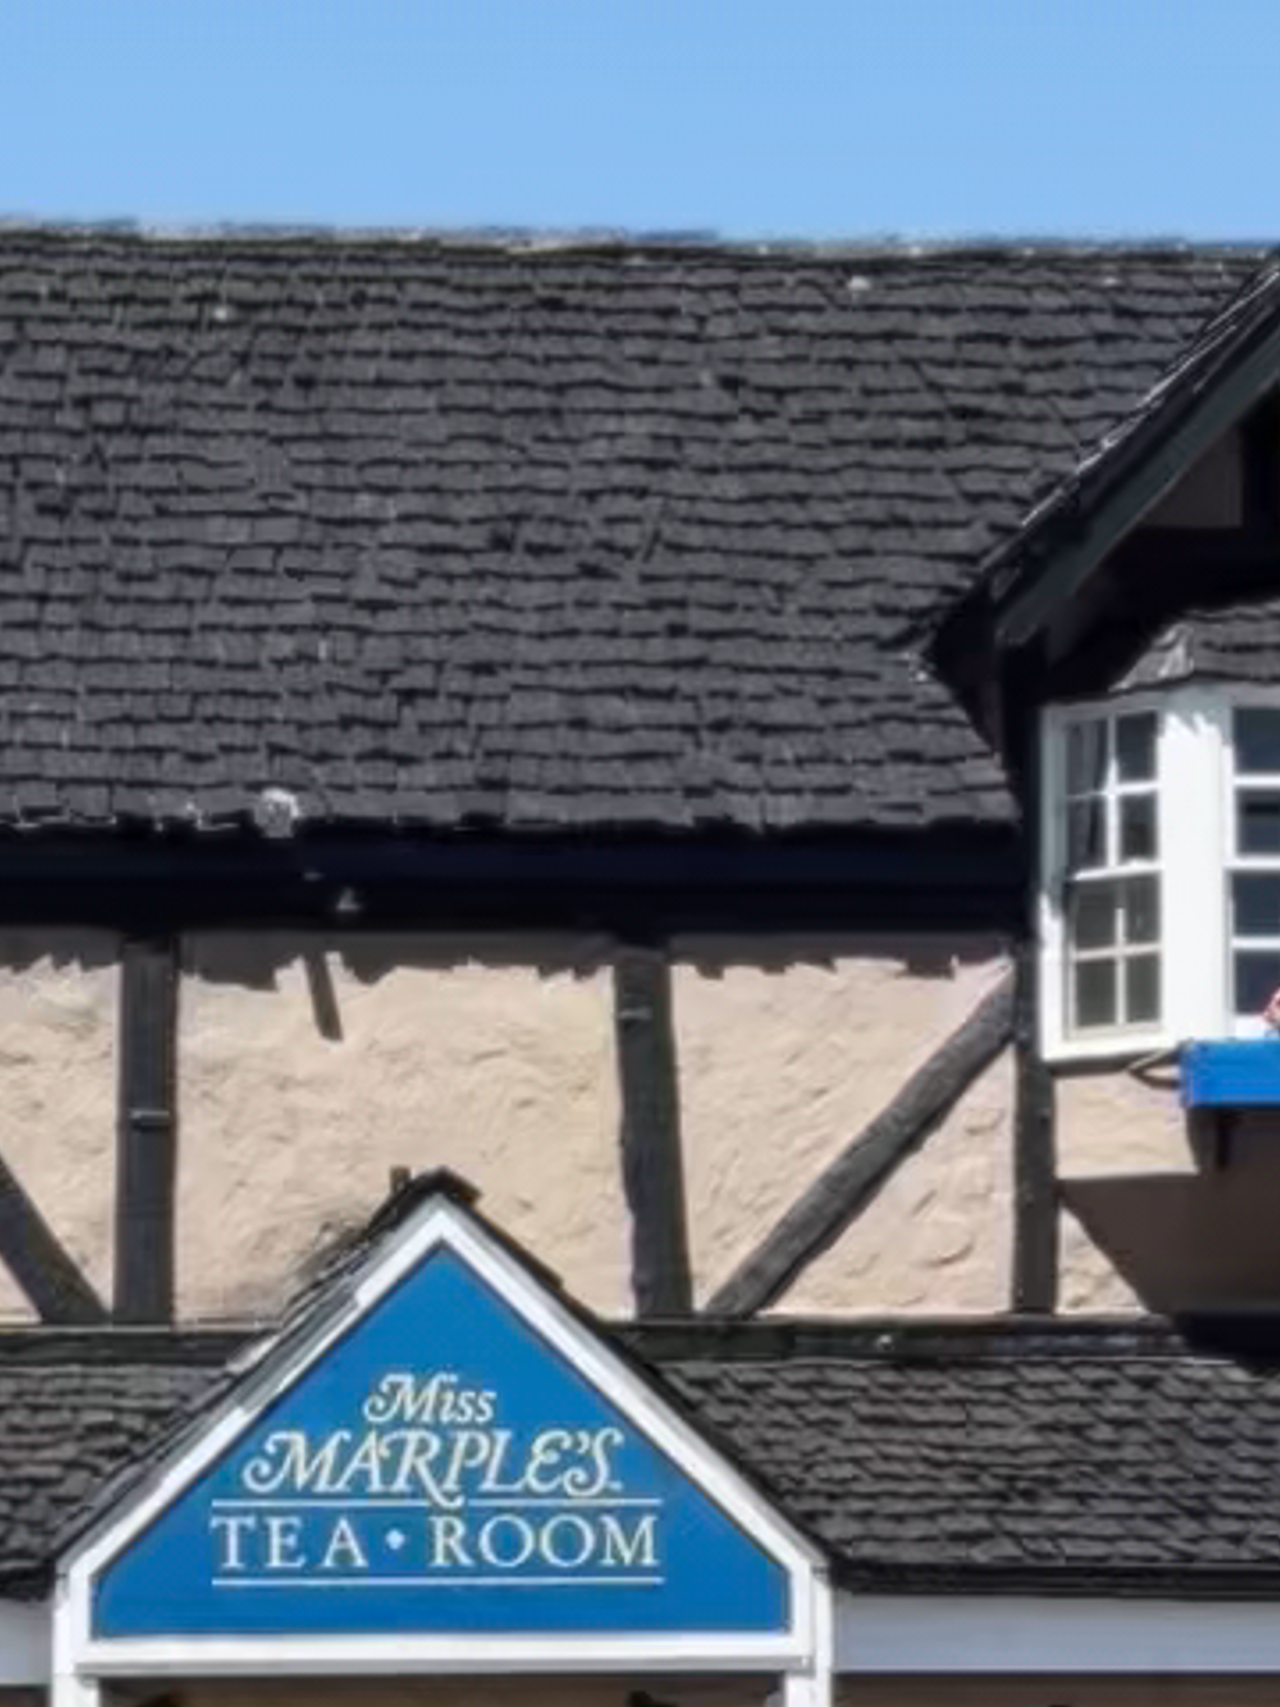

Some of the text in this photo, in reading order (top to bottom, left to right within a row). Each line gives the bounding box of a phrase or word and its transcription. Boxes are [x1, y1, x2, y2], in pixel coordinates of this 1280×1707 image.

[363, 1373, 498, 1424] Miss
[243, 1428, 625, 1508] MARPLE'S
[211, 1515, 660, 1569] TEA ROOM
